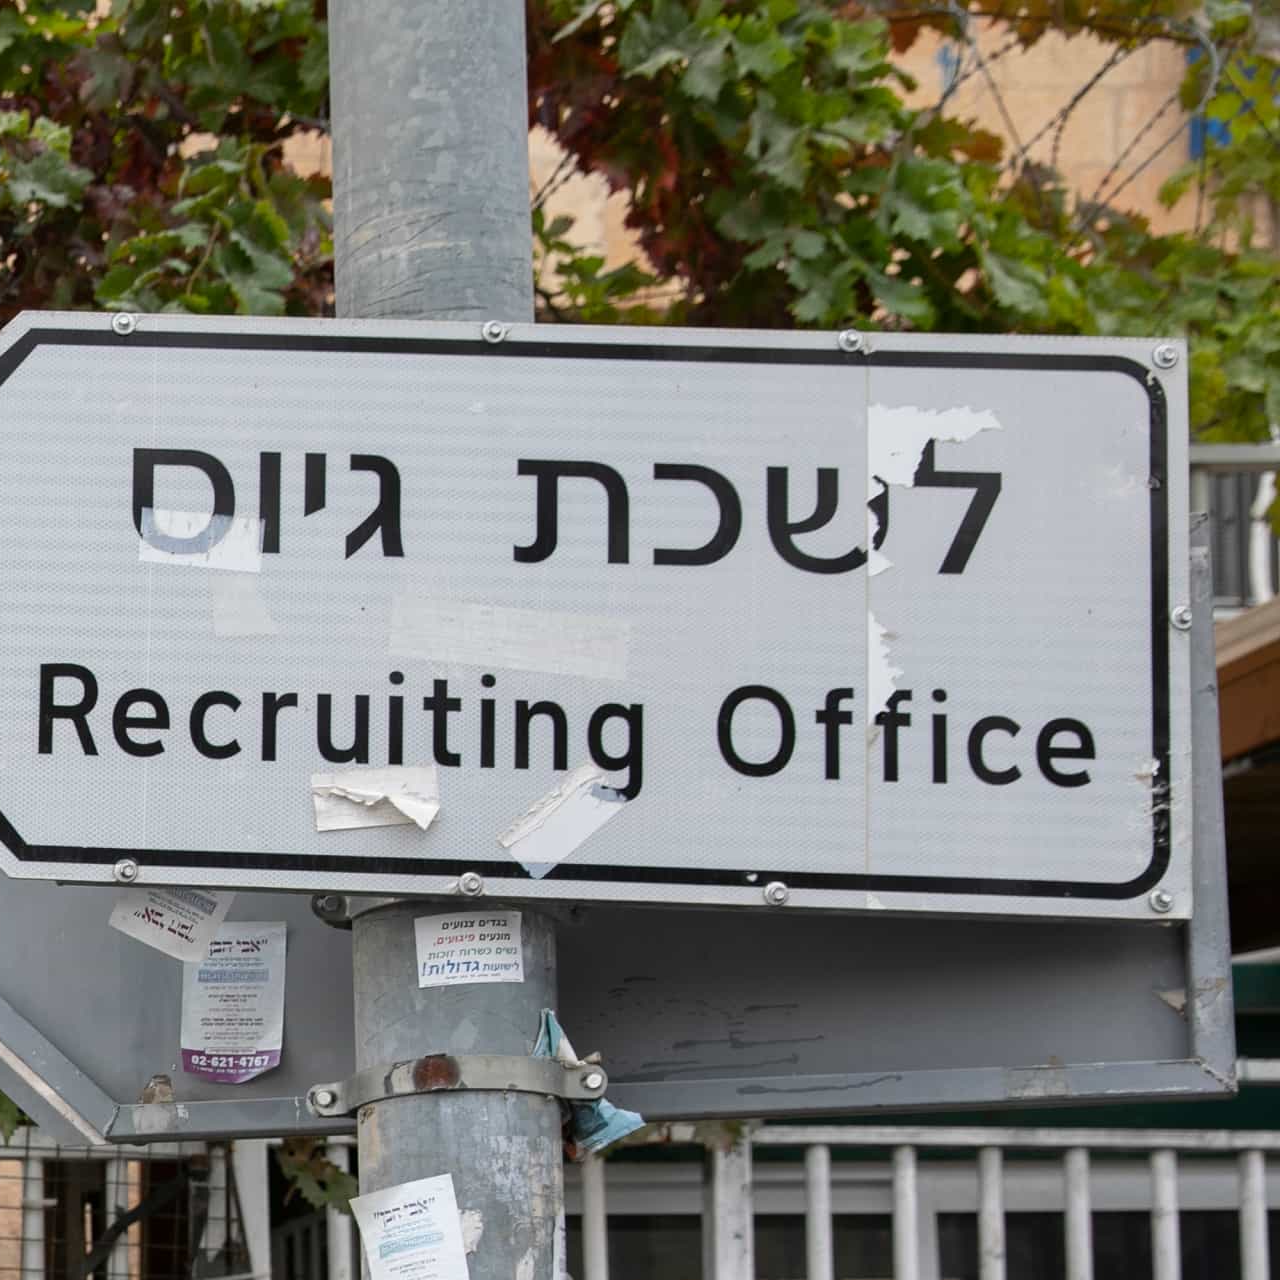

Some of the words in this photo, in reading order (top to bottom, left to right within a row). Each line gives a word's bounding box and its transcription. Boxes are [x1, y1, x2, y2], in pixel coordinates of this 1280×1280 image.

[132, 447, 405, 561] גיוס
[514, 437, 1002, 575] לשכת
[38, 662, 644, 801] Recruiting
[716, 684, 1097, 788] Office
